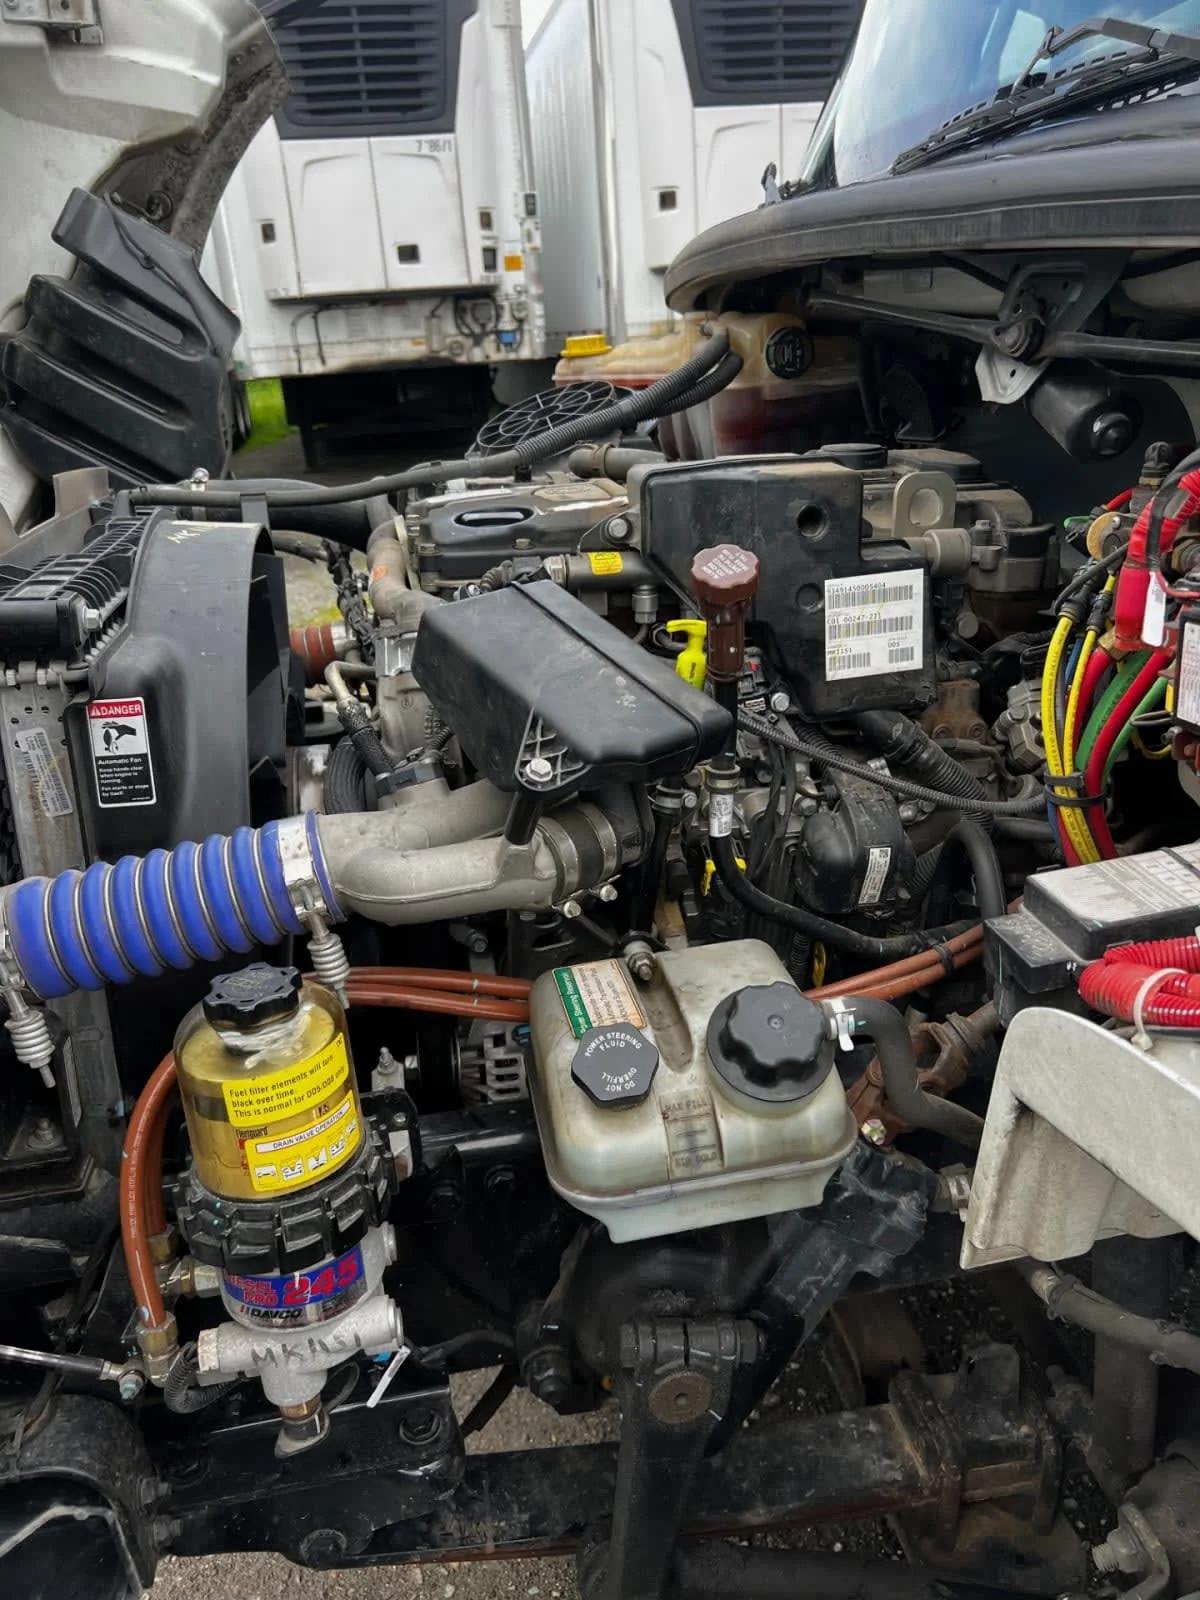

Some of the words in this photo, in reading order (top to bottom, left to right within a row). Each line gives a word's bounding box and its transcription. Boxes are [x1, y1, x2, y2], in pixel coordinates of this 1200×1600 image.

[100, 704, 142, 716] DANGER
[584, 1032, 606, 1057] POWER
[606, 1031, 642, 1050] STEERING
[599, 1040, 627, 1052] FLUID
[229, 1088, 247, 1097] Fuel
[248, 1086, 269, 1096] filter
[271, 1071, 308, 1091] elements
[308, 1062, 322, 1076] will
[321, 1055, 334, 1067] turn
[601, 1066, 638, 1084] OVERFILL
[605, 1084, 622, 1092] NOT
[624, 1080, 636, 1090] DO
[231, 1099, 254, 1108] black
[255, 1095, 274, 1105] over
[233, 1109, 252, 1118] This
[263, 1098, 293, 1113] normal
[293, 1095, 305, 1105] for
[273, 1138, 294, 1149] DRAIN
[294, 1130, 315, 1142] VALVE
[315, 1111, 343, 1133] OPERATION
[283, 1251, 358, 1306] 245
[243, 1290, 279, 1306] PRO
[250, 1308, 303, 1320] DAVCO
